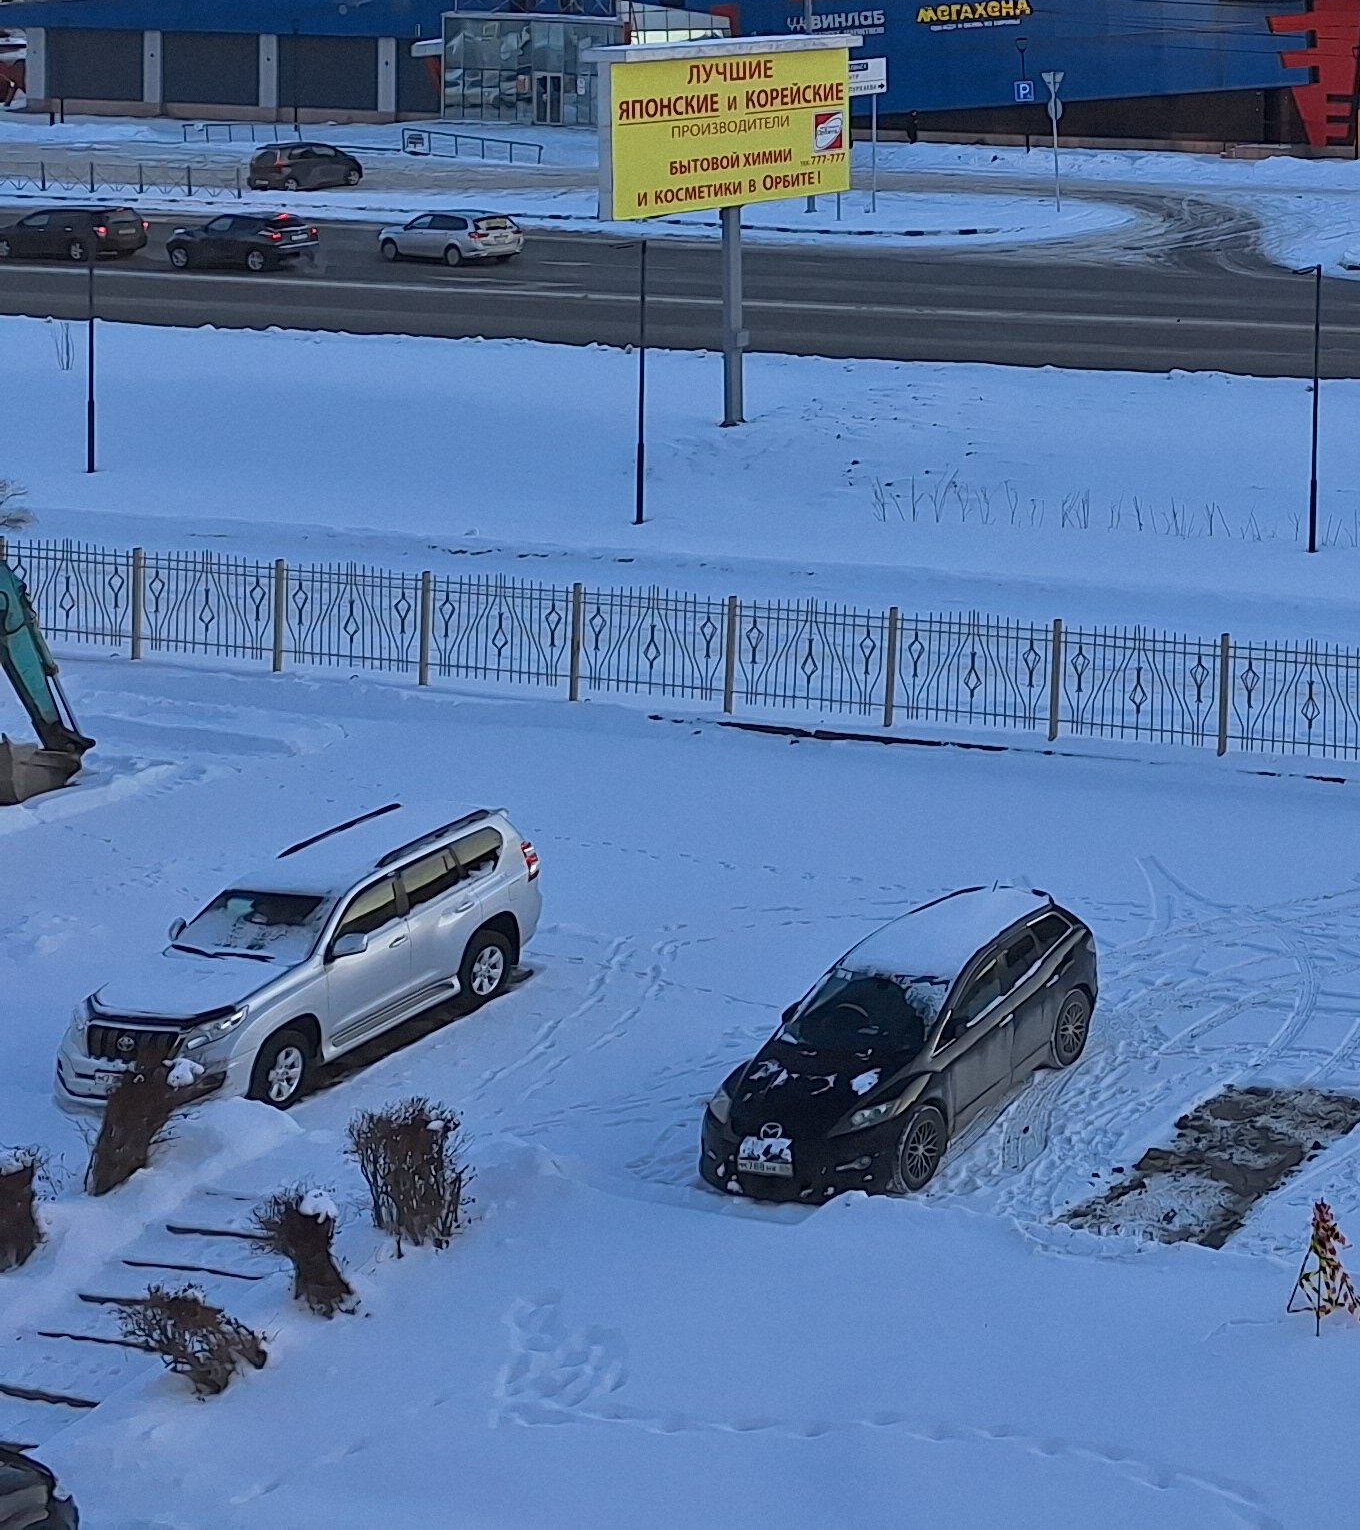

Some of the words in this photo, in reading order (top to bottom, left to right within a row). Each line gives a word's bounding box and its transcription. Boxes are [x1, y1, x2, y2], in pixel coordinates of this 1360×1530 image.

[687, 60, 773, 84] ЛУЧШИЕ
[619, 93, 719, 120] ЯПОНСКИЕ
[745, 83, 844, 109] КОРЕЙСКИЕ
[671, 116, 790, 138] ПРОИЗВОДИТЕЛИ
[670, 151, 740, 175] БЫТОВОЙ
[743, 148, 792, 168] ХИМИИ
[811, 153, 845, 165] 777-777
[637, 192, 648, 207] И
[654, 181, 742, 205] КОСМЕТИКИ
[749, 178, 757, 193] В
